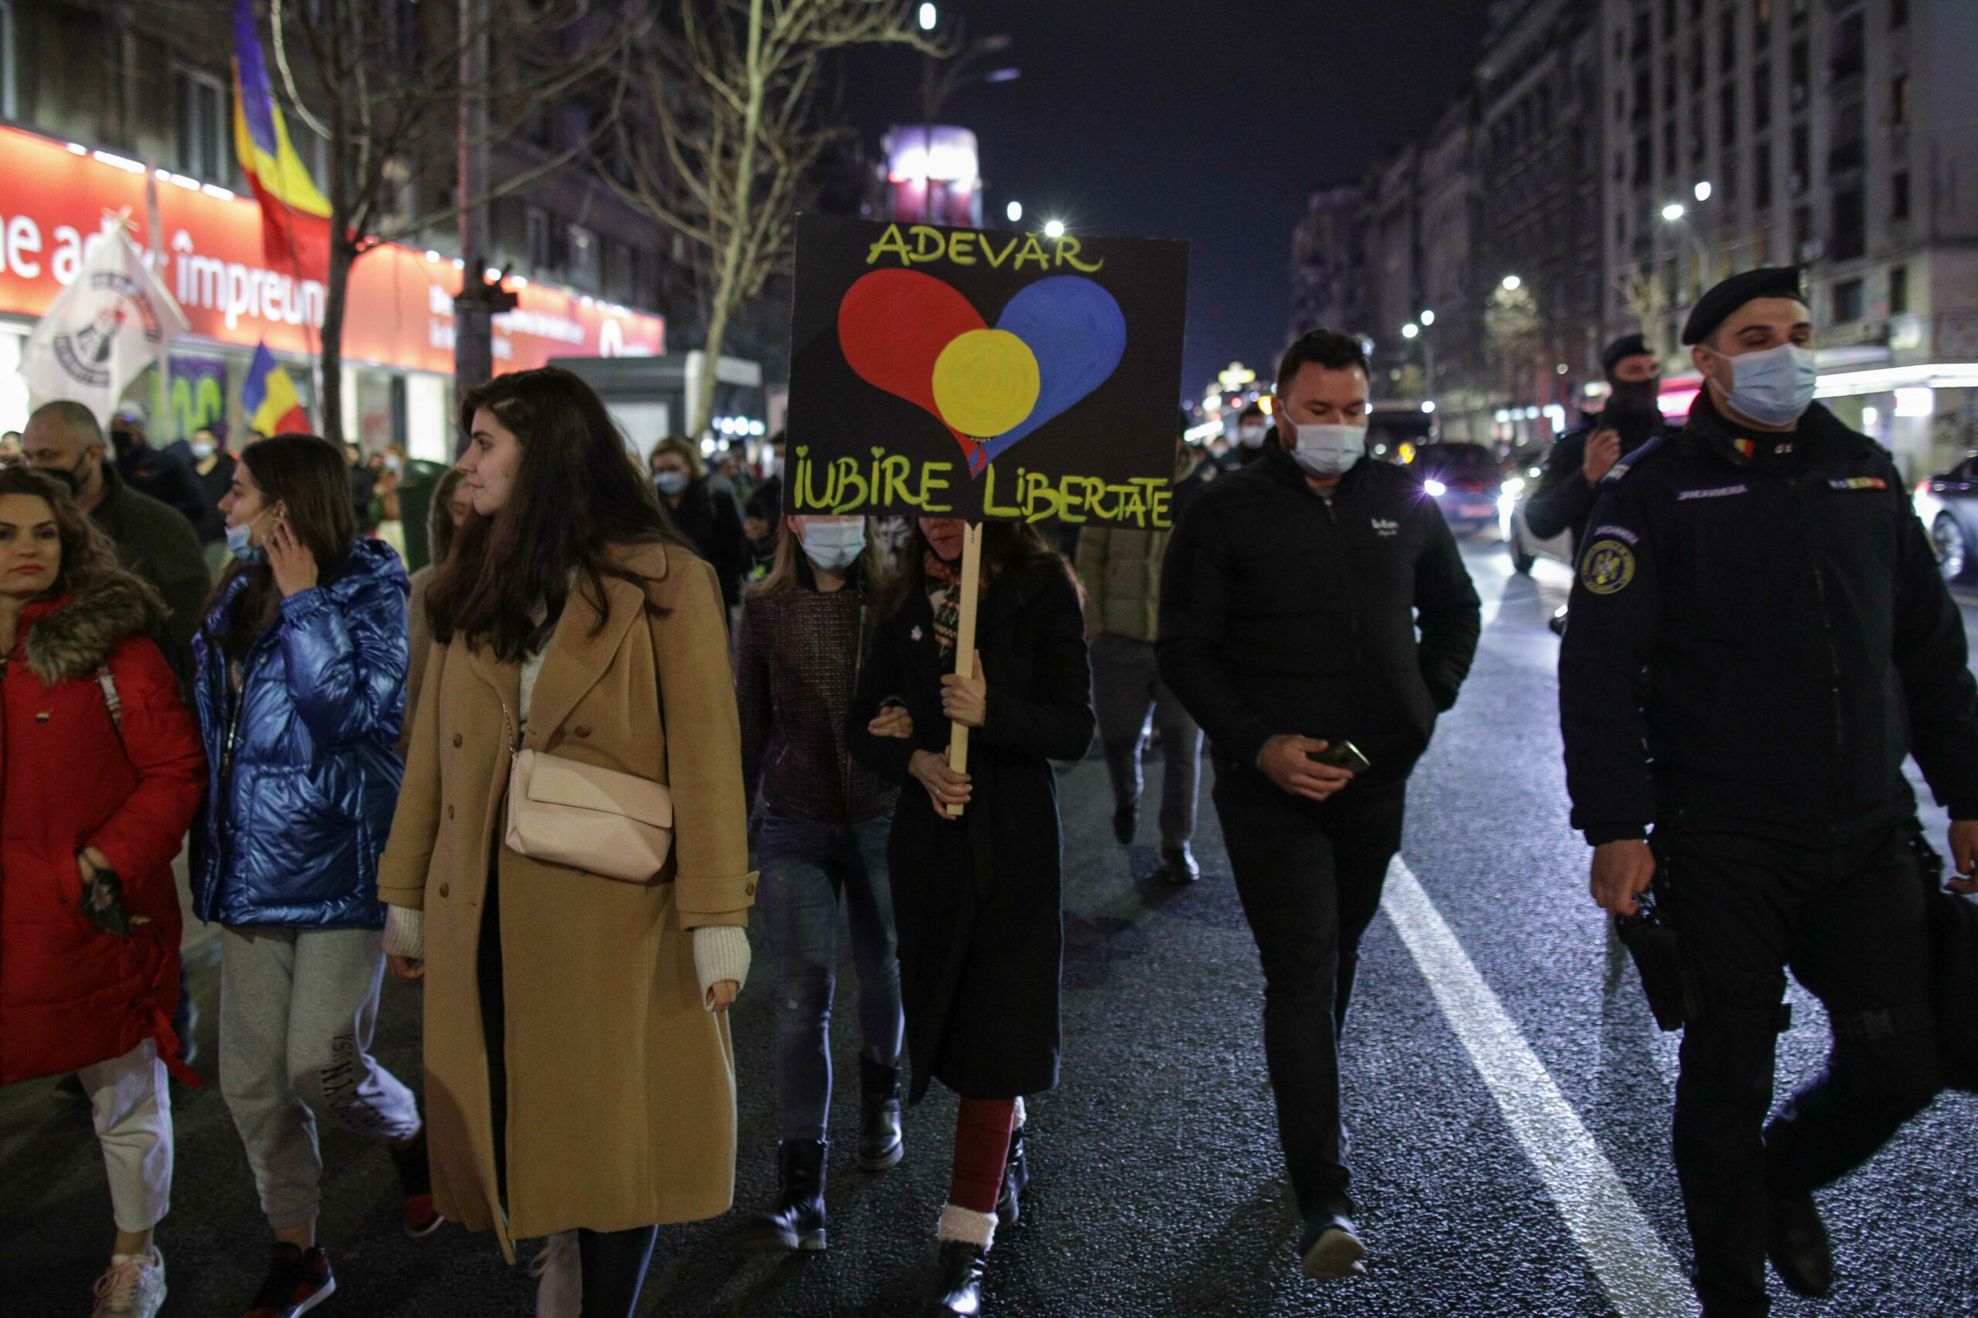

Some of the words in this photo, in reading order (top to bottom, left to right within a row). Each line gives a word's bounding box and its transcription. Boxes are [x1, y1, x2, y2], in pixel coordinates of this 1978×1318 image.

[0, 213, 43, 280] e
[171, 229, 328, 331] împreun
[866, 223, 1104, 273] ADEVĂR
